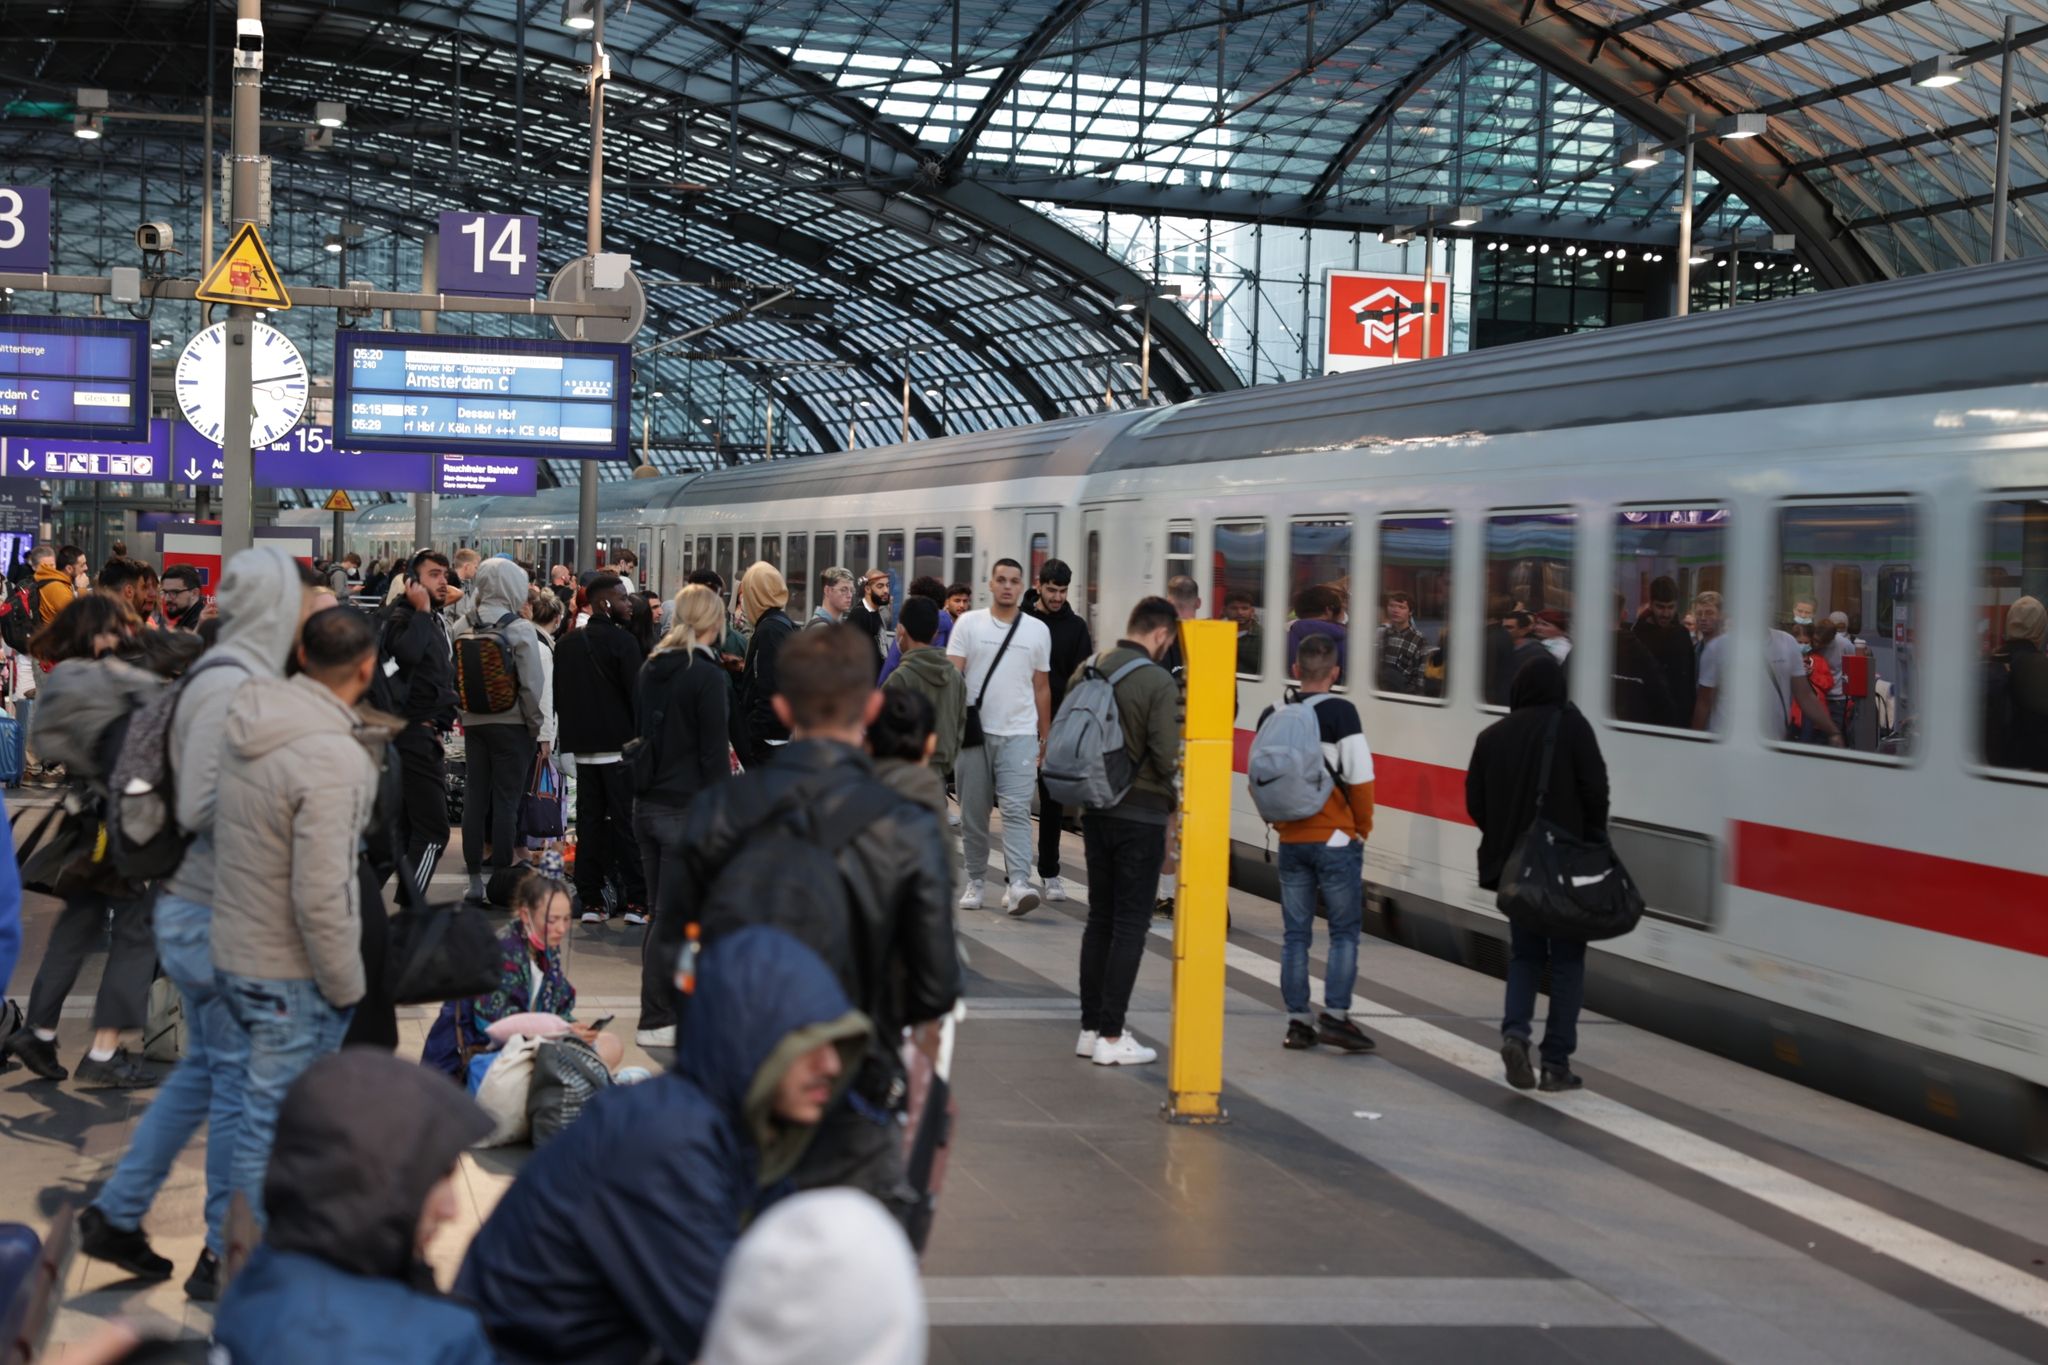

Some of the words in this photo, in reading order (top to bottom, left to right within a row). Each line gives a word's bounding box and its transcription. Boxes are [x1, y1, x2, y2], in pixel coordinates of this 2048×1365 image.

[462, 217, 527, 275] 14
[353, 349, 383, 360] 05:20
[353, 360, 361, 368] IC
[362, 361, 377, 369] 240
[405, 363, 440, 372] Hannover
[442, 364, 455, 373] Hbf
[502, 367, 516, 375] Hbf
[406, 372, 494, 390] Amsterdam
[498, 376, 509, 391] C
[31, 390, 40, 400] C
[352, 404, 382, 414] 05:15
[404, 406, 417, 416] RE
[421, 406, 428, 416] 7
[458, 408, 495, 418] Dessau
[498, 409, 516, 420] Hbf
[352, 419, 381, 430] 05:29
[417, 422, 435, 432] Hbf
[448, 422, 471, 434] Köln
[474, 423, 492, 434] Hbf
[519, 425, 534, 436] ICE
[271, 442, 290, 452] und
[443, 464, 486, 474] Rauchfreier
[486, 465, 518, 474] Bahnhof
